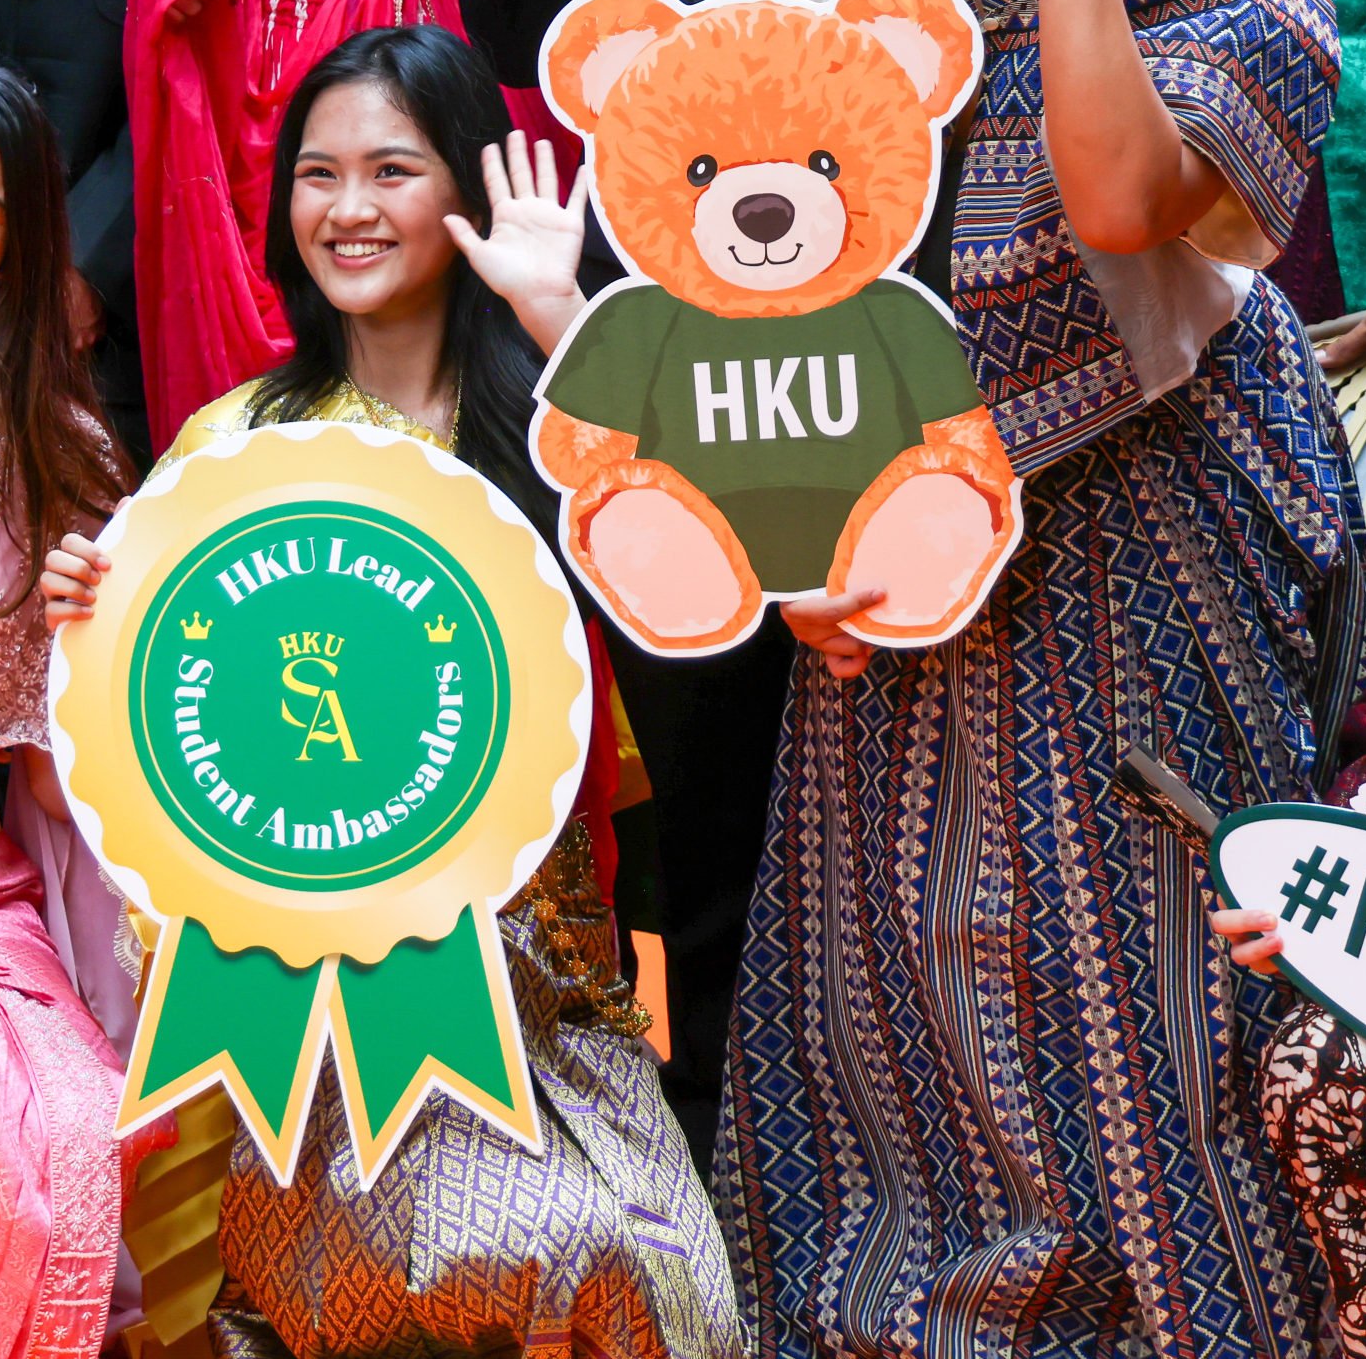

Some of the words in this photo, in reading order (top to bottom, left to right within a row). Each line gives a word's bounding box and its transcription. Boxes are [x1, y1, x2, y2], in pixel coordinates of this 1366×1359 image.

[693, 354, 859, 443] HKU
[215, 537, 316, 605] HKU
[325, 537, 436, 612] Lead
[278, 631, 345, 659] HKU
[174, 653, 257, 827] Student
[256, 660, 464, 850] Ambassadors
